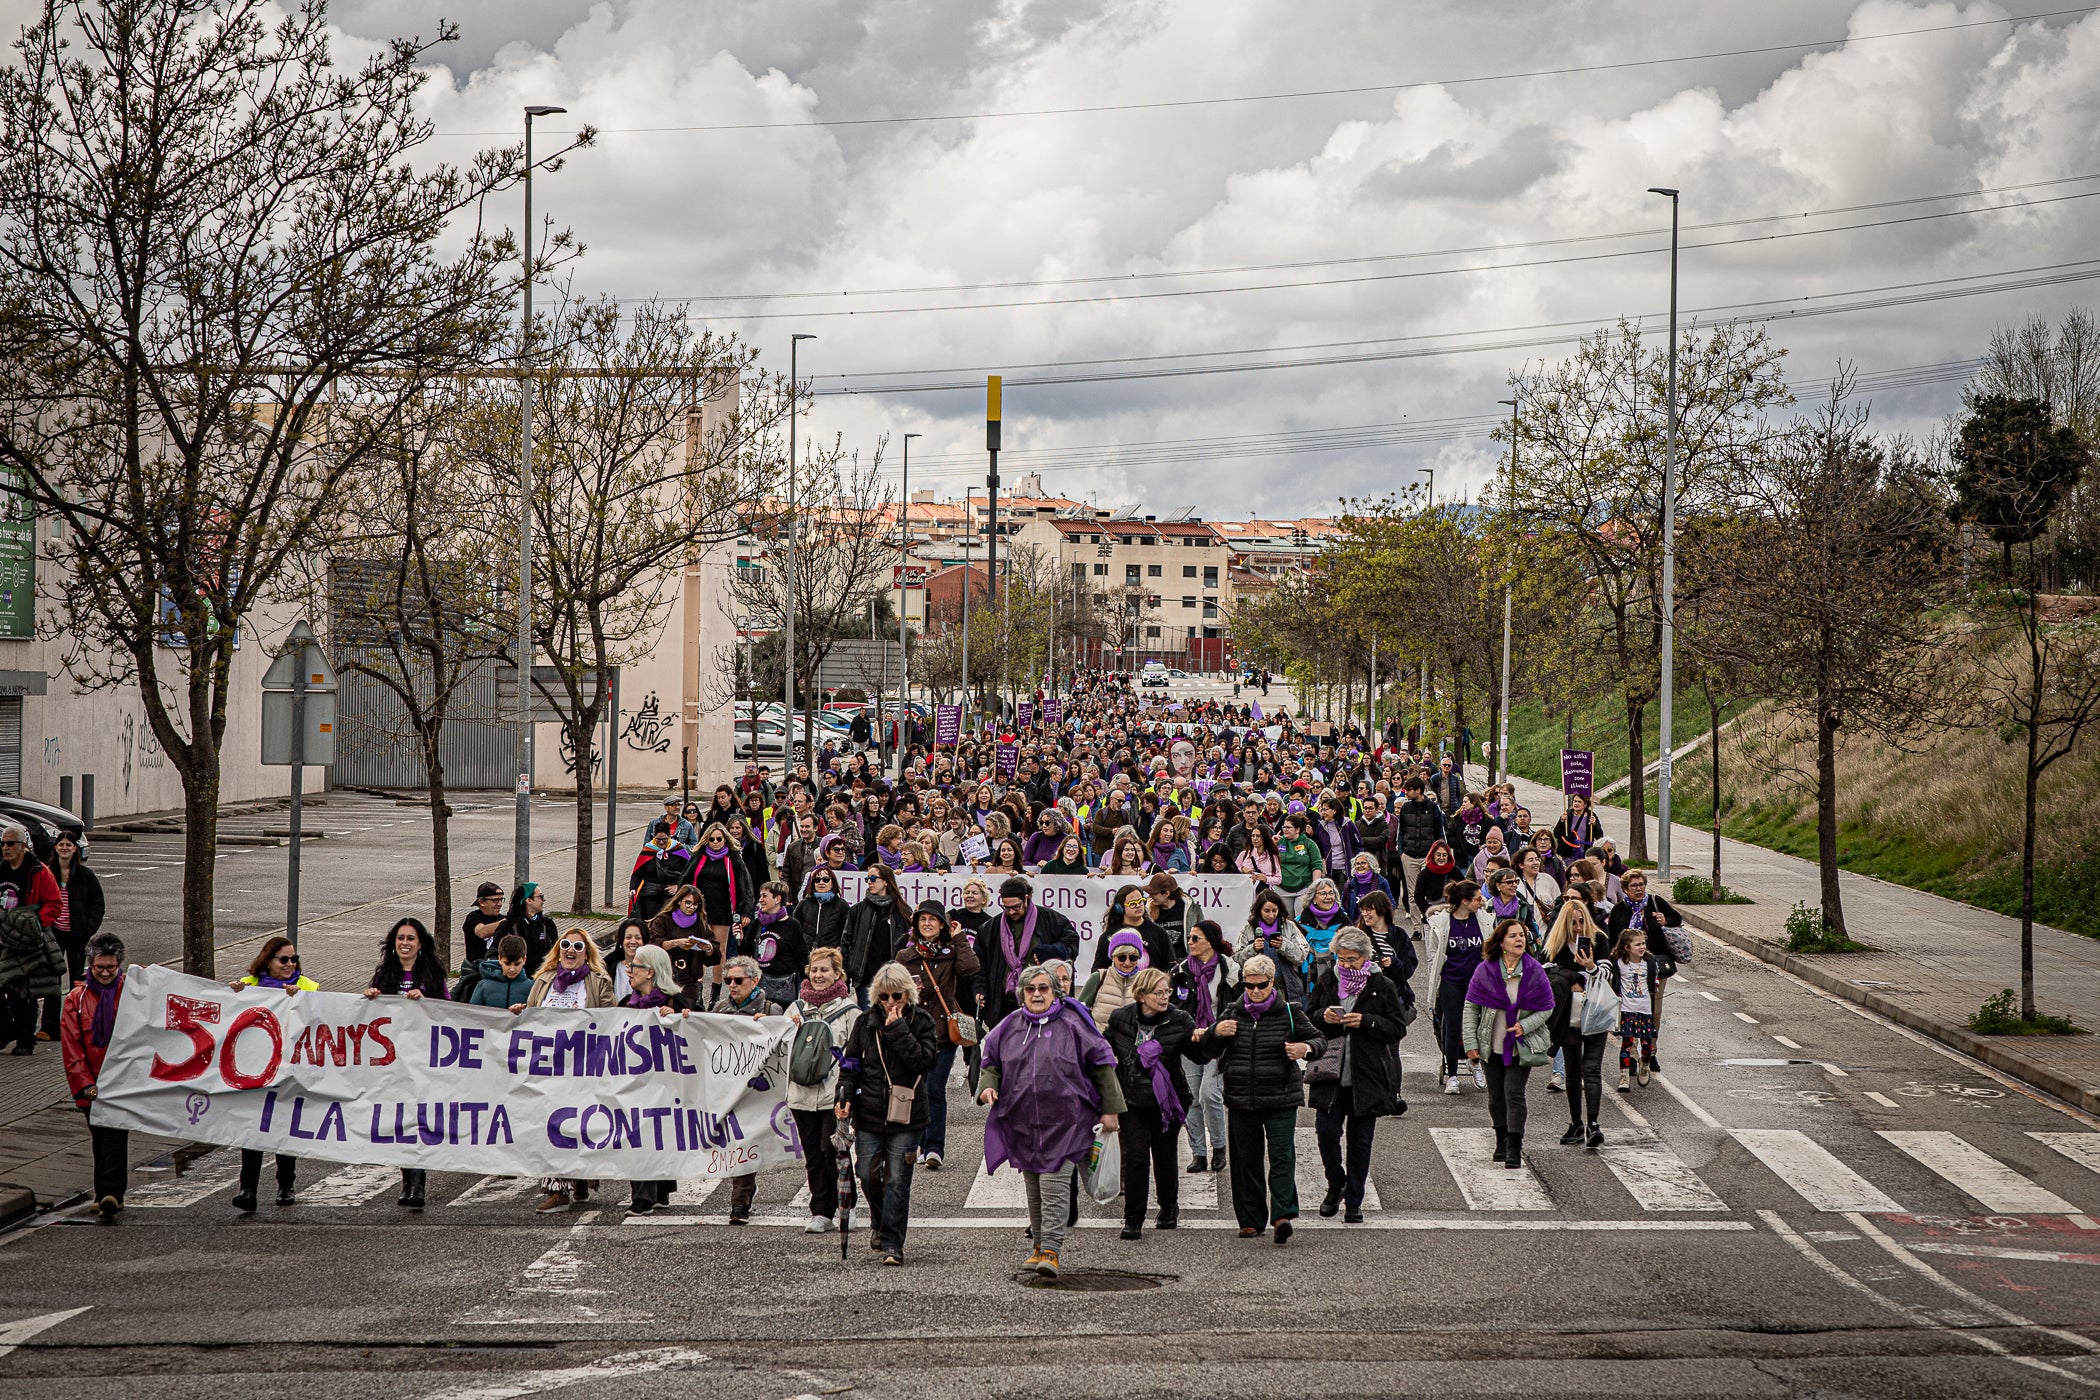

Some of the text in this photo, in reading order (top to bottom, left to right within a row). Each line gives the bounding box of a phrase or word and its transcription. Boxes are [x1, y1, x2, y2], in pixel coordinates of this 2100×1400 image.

[841, 877, 861, 905] El
[1042, 887, 1087, 909] ens
[149, 993, 283, 1091] 50
[290, 1016, 397, 1068] ANYS
[429, 1025, 485, 1069] DE
[289, 1097, 347, 1141] LA
[370, 1102, 514, 1146] LLUITA
